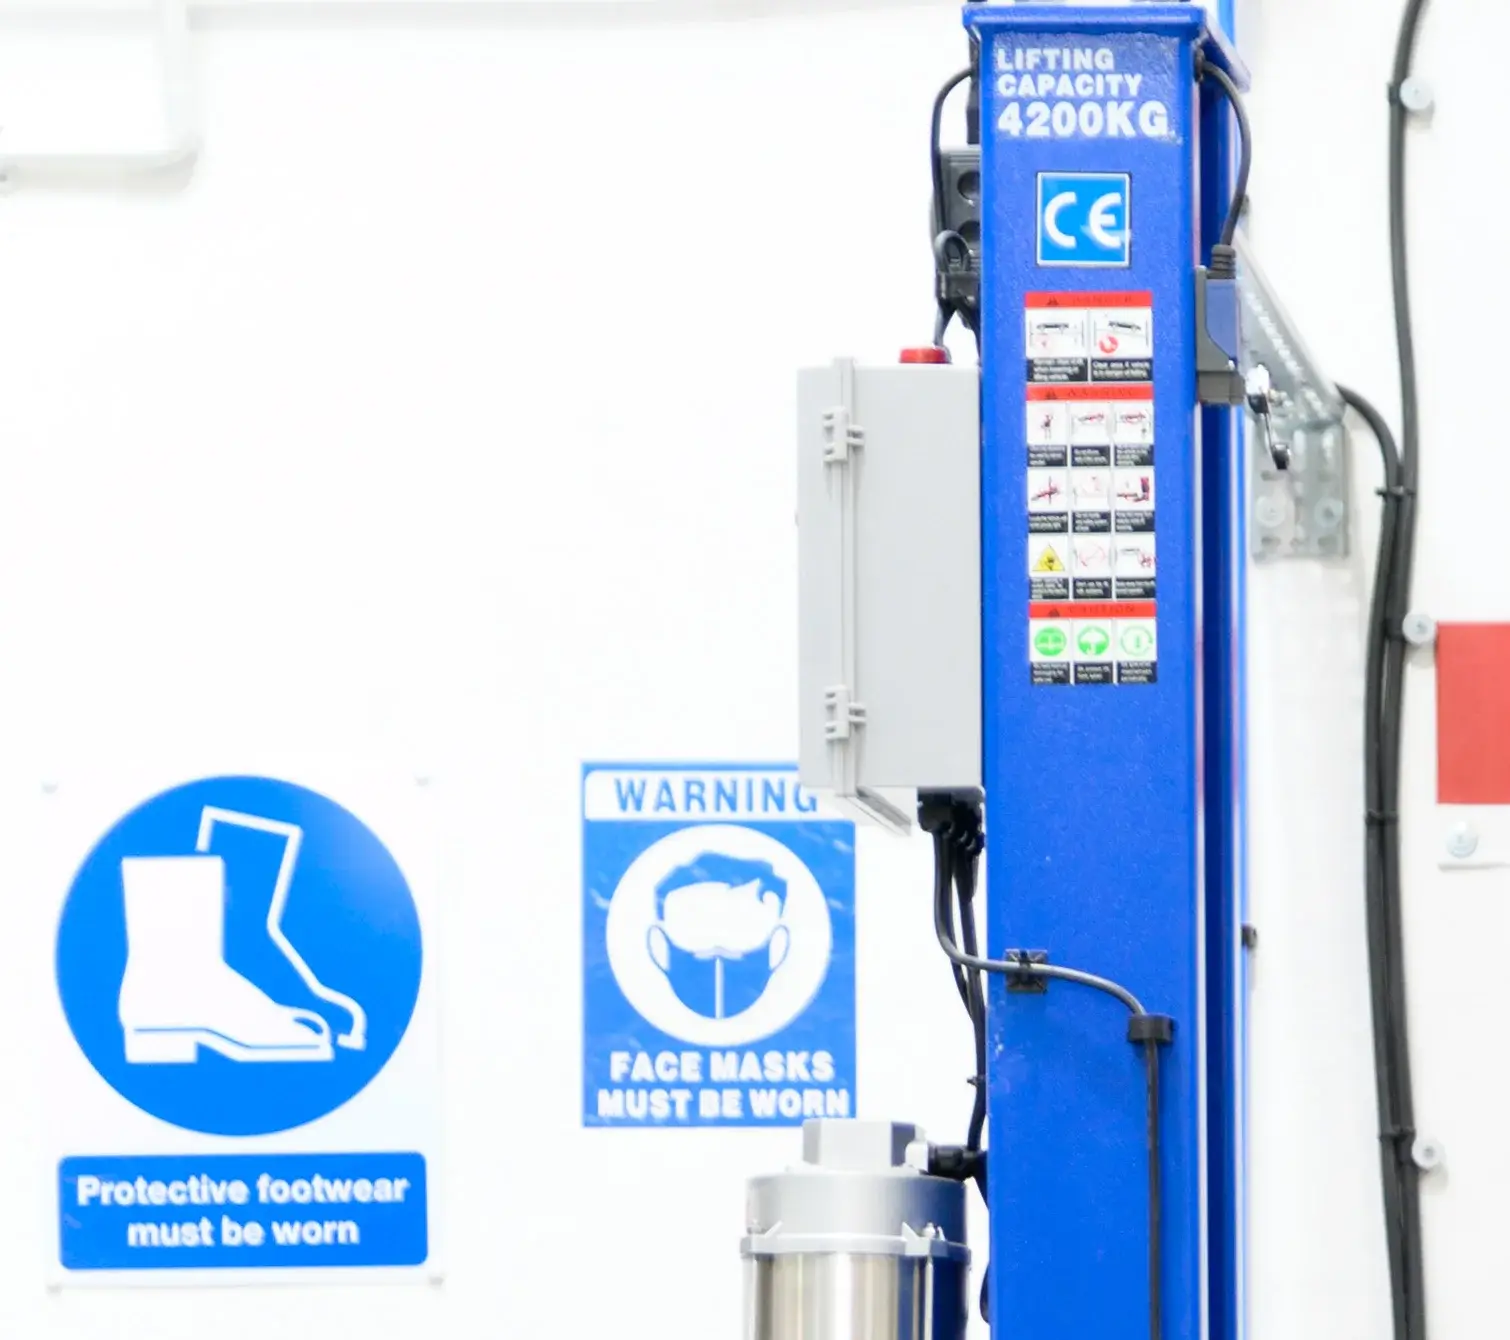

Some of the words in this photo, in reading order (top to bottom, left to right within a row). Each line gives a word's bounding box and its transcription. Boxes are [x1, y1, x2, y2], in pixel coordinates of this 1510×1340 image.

[997, 48, 1115, 70] LIFTING
[997, 74, 1142, 97] CAPACITY
[997, 101, 1169, 138] 4200KG
[614, 778, 818, 812] WARNING
[610, 1051, 702, 1081] FACE
[710, 1051, 835, 1081] MASKS
[598, 1090, 692, 1117] MUST
[700, 1090, 743, 1117] BE
[749, 1090, 850, 1118] WORN
[77, 1174, 250, 1206] Protective
[256, 1172, 410, 1203] footwear
[127, 1217, 212, 1246] must
[220, 1215, 264, 1245] be
[273, 1219, 359, 1244] worn
